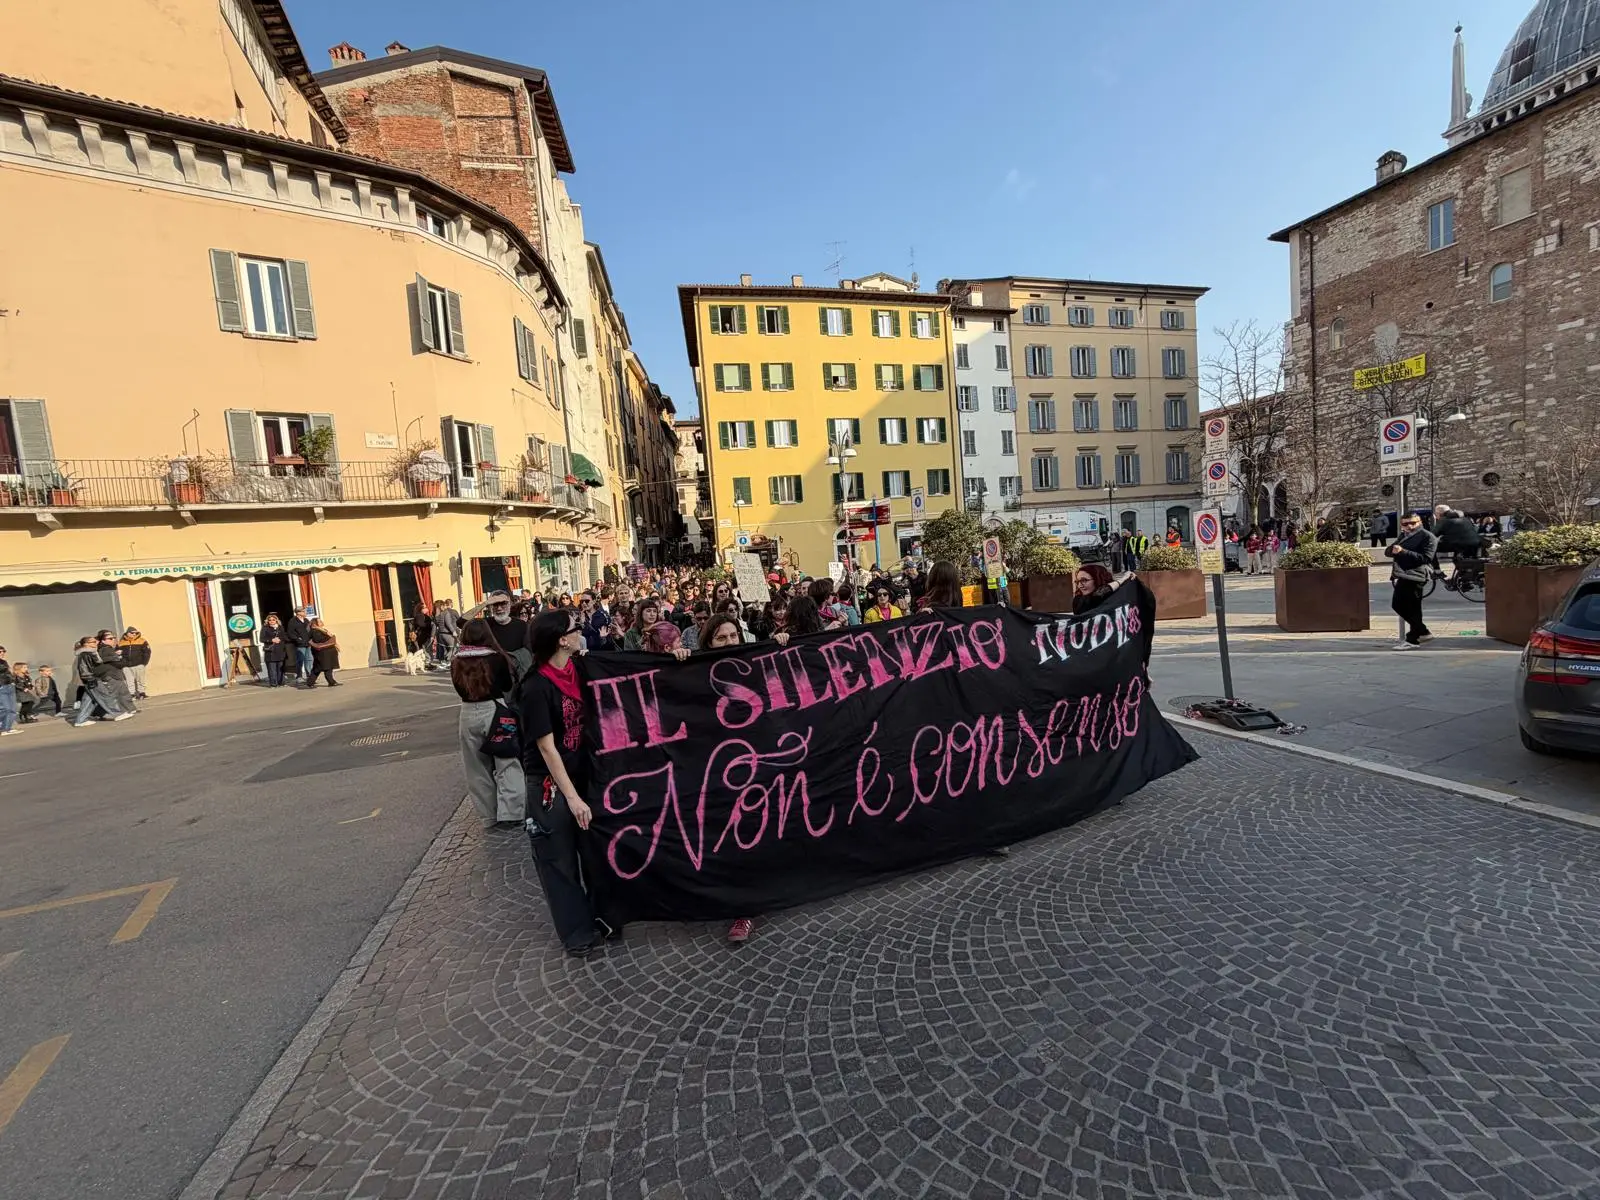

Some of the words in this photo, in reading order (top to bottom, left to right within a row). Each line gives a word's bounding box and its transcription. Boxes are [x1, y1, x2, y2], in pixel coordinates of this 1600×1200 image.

[129, 567, 171, 576] FERMATA
[222, 561, 284, 570] TRAMEZZINERIA
[291, 557, 336, 566] PANINOTECA
[587, 669, 688, 755] IL
[710, 618, 1006, 728] SILENZIO
[603, 726, 834, 879] Non
